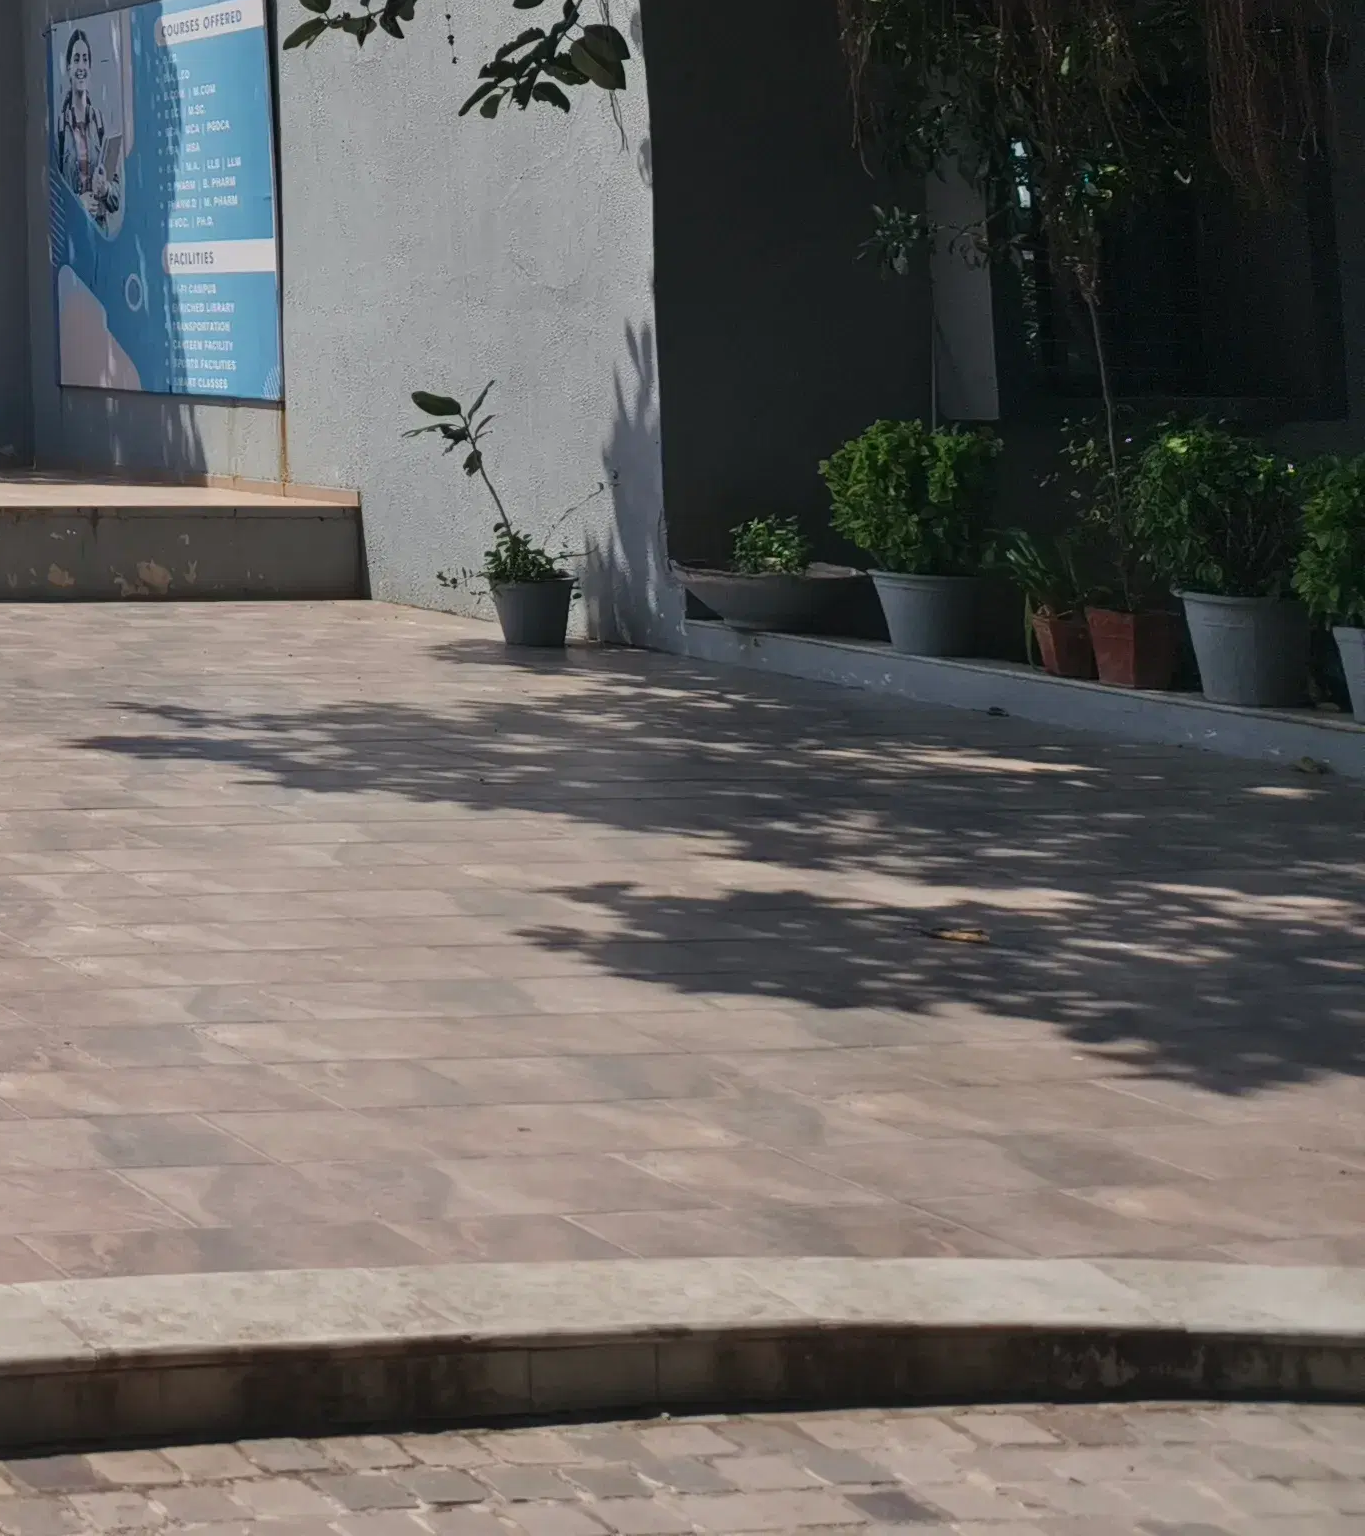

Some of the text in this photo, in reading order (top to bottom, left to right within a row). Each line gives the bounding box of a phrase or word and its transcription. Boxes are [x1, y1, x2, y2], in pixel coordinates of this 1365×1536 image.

[161, 9, 243, 38] COURSES OFFERED
[211, 175, 236, 188] PHARM
[213, 195, 238, 206] PHARM
[169, 250, 215, 266] FACILITIES
[188, 283, 217, 294] CAMPUS
[206, 302, 235, 313] LIBRARY
[204, 341, 234, 351] FACILITY
[200, 358, 237, 371] FACILITIES
[197, 378, 229, 390] CLASSES
